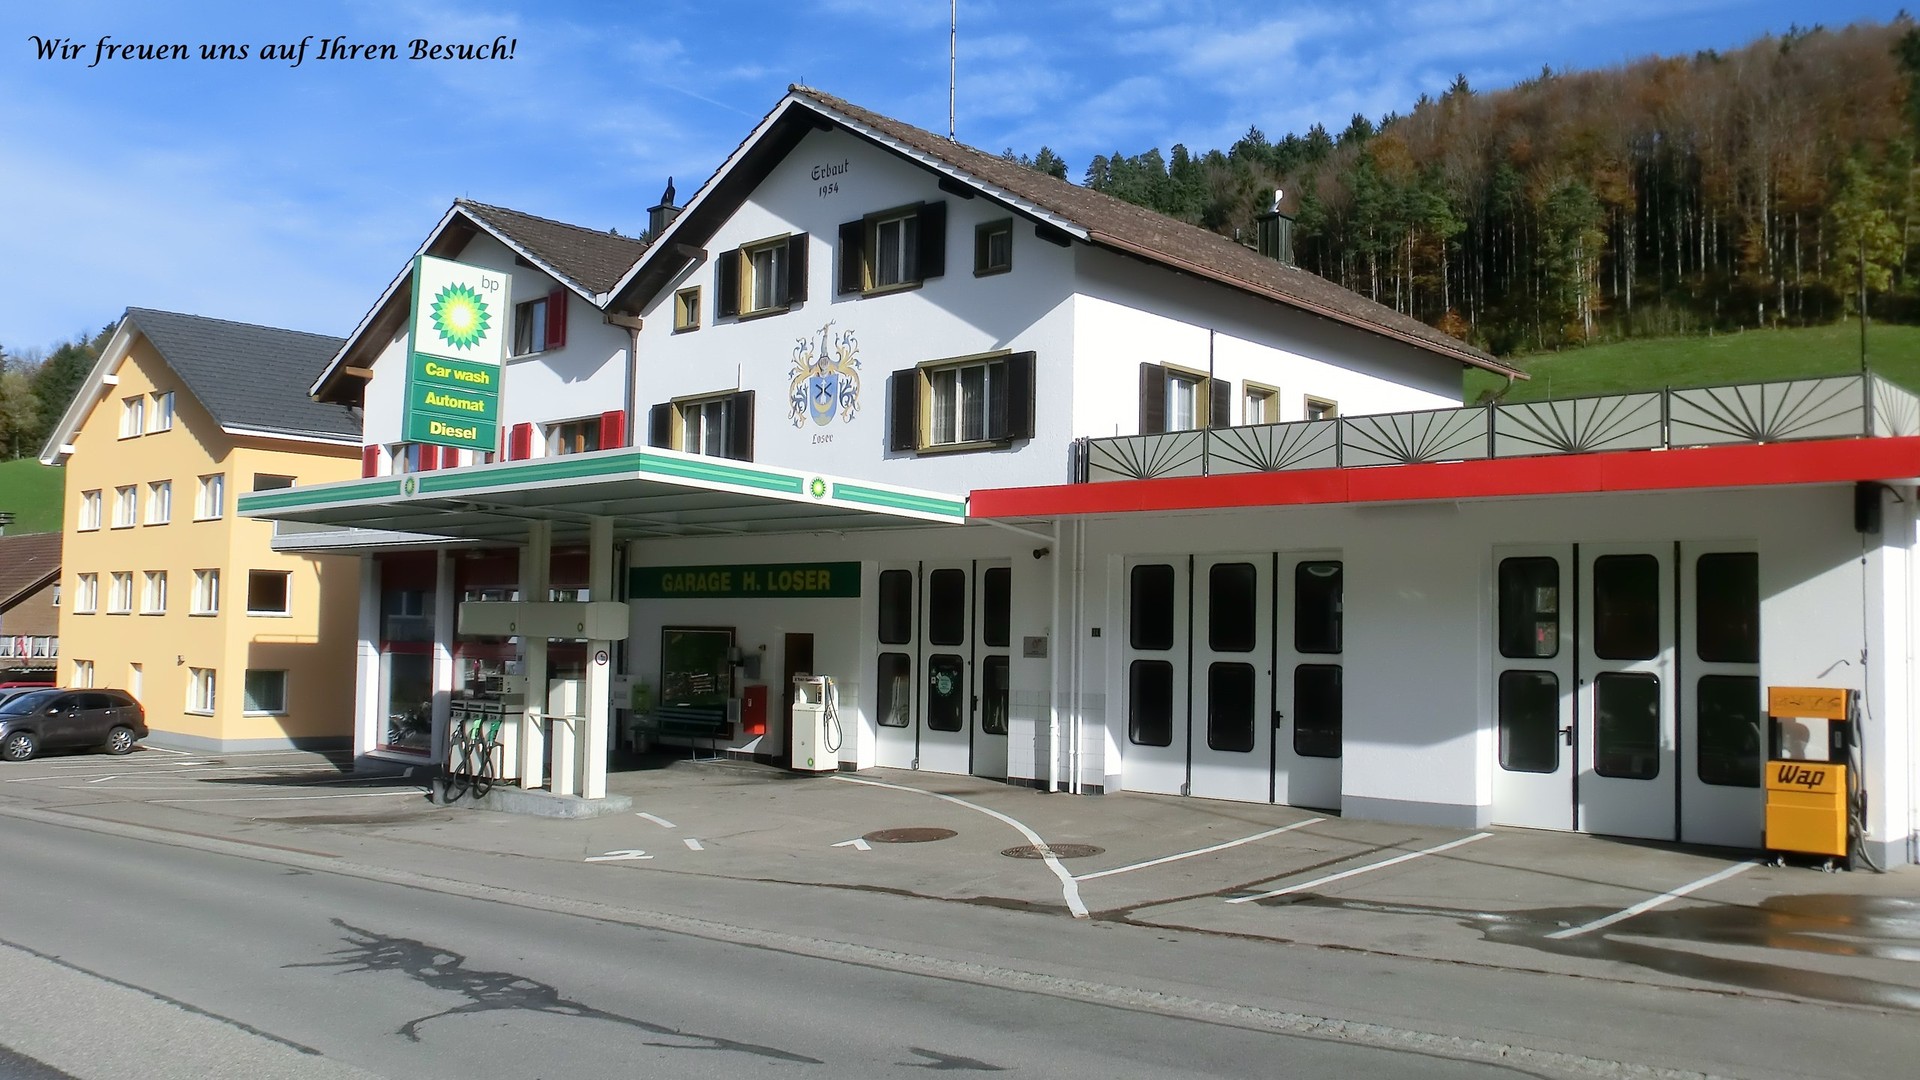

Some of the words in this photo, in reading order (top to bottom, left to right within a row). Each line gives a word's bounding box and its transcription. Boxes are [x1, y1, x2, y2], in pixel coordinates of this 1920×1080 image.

[811, 159, 849, 181] Erbaut
[819, 182, 839, 199] 1954
[481, 275, 499, 292] bp
[425, 362, 451, 378] Car
[453, 369, 490, 385] wash
[425, 391, 484, 413] Automat
[430, 421, 477, 440] Diesel
[662, 572, 731, 592] GARAGE
[743, 572, 761, 591] H.
[768, 570, 831, 591] LOSER
[1777, 764, 1825, 789] Wap
